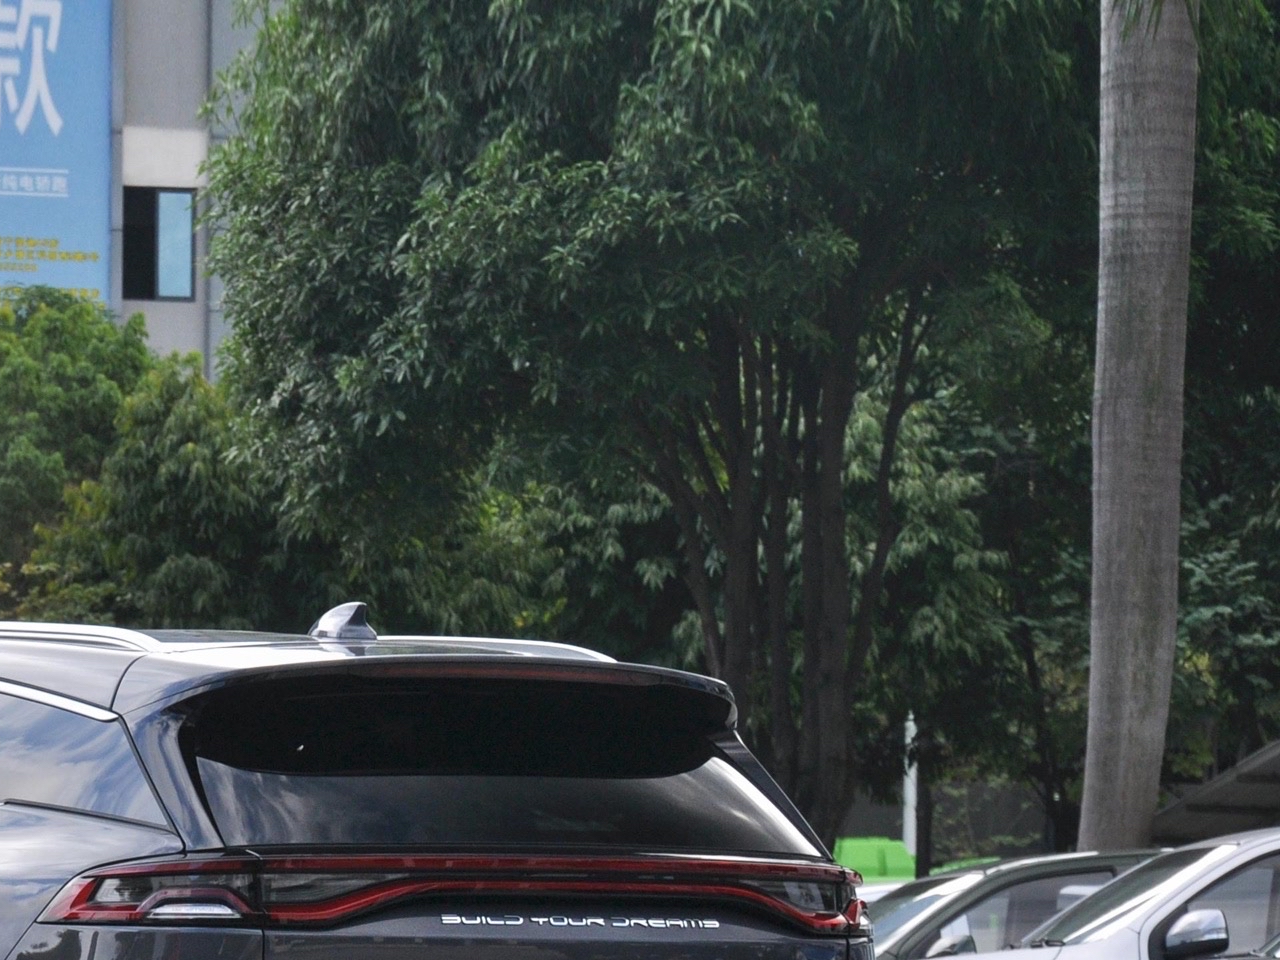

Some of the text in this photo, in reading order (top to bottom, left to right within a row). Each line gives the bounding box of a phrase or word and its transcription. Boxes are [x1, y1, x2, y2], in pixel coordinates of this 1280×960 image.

[441, 914, 720, 929] BUILD YOUR DREAMS
